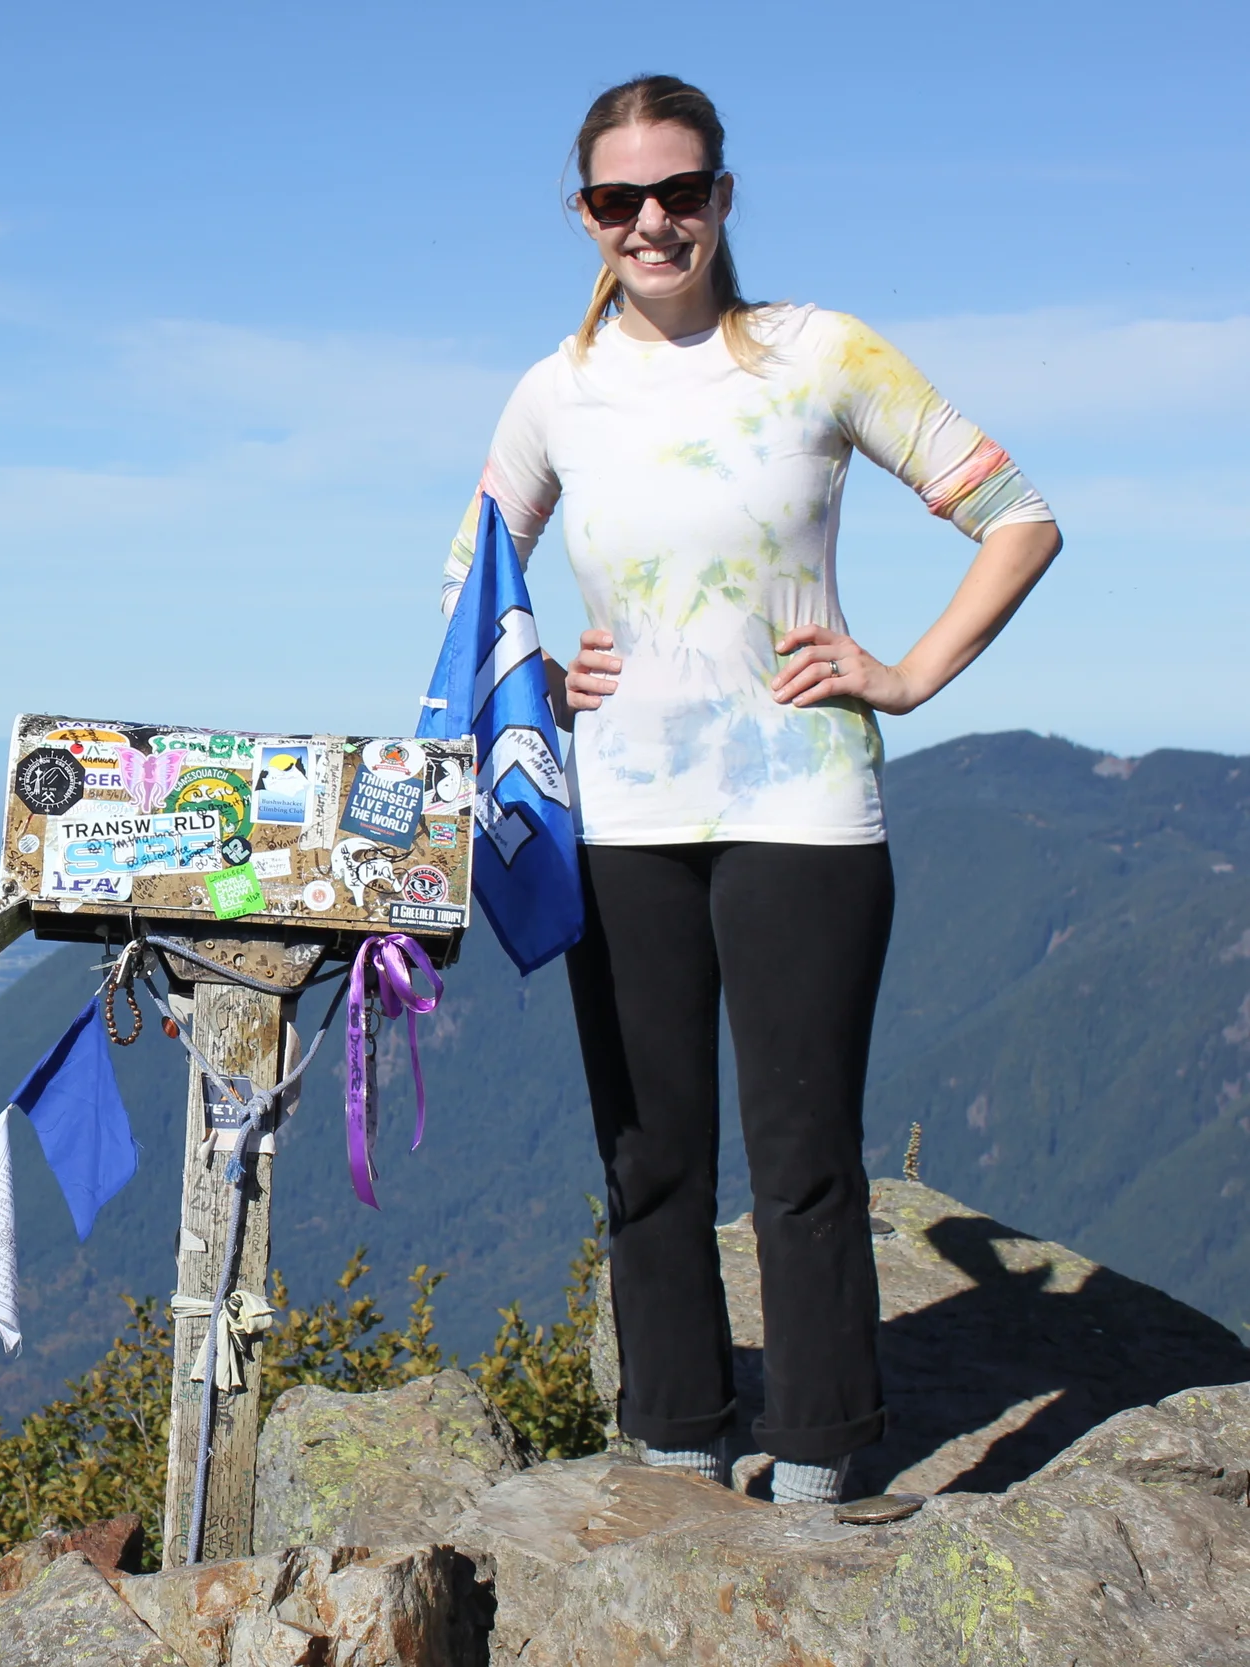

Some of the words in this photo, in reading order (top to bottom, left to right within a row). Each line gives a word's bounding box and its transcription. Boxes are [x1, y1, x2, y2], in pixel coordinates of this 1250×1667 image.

[507, 730, 557, 775] PRAKASH
[83, 772, 121, 787] GER
[361, 772, 395, 791] THINK
[397, 783, 421, 799] FOR
[261, 799, 302, 807] Bushwhacker
[358, 783, 418, 809] YOURSELF
[259, 806, 288, 814] Climbing
[352, 795, 383, 812] LIVE
[387, 806, 414, 822] FOR
[350, 807, 370, 821] THE
[371, 815, 409, 834] WORLD
[213, 874, 247, 889] WORLD
[413, 869, 443, 884] WISCONSIN
[215, 880, 252, 896] CHANGE
[217, 892, 227, 901] IS
[228, 886, 250, 898] HOW
[220, 897, 245, 909] ROLL
[392, 906, 399, 917] A
[437, 910, 461, 923] TODAY
